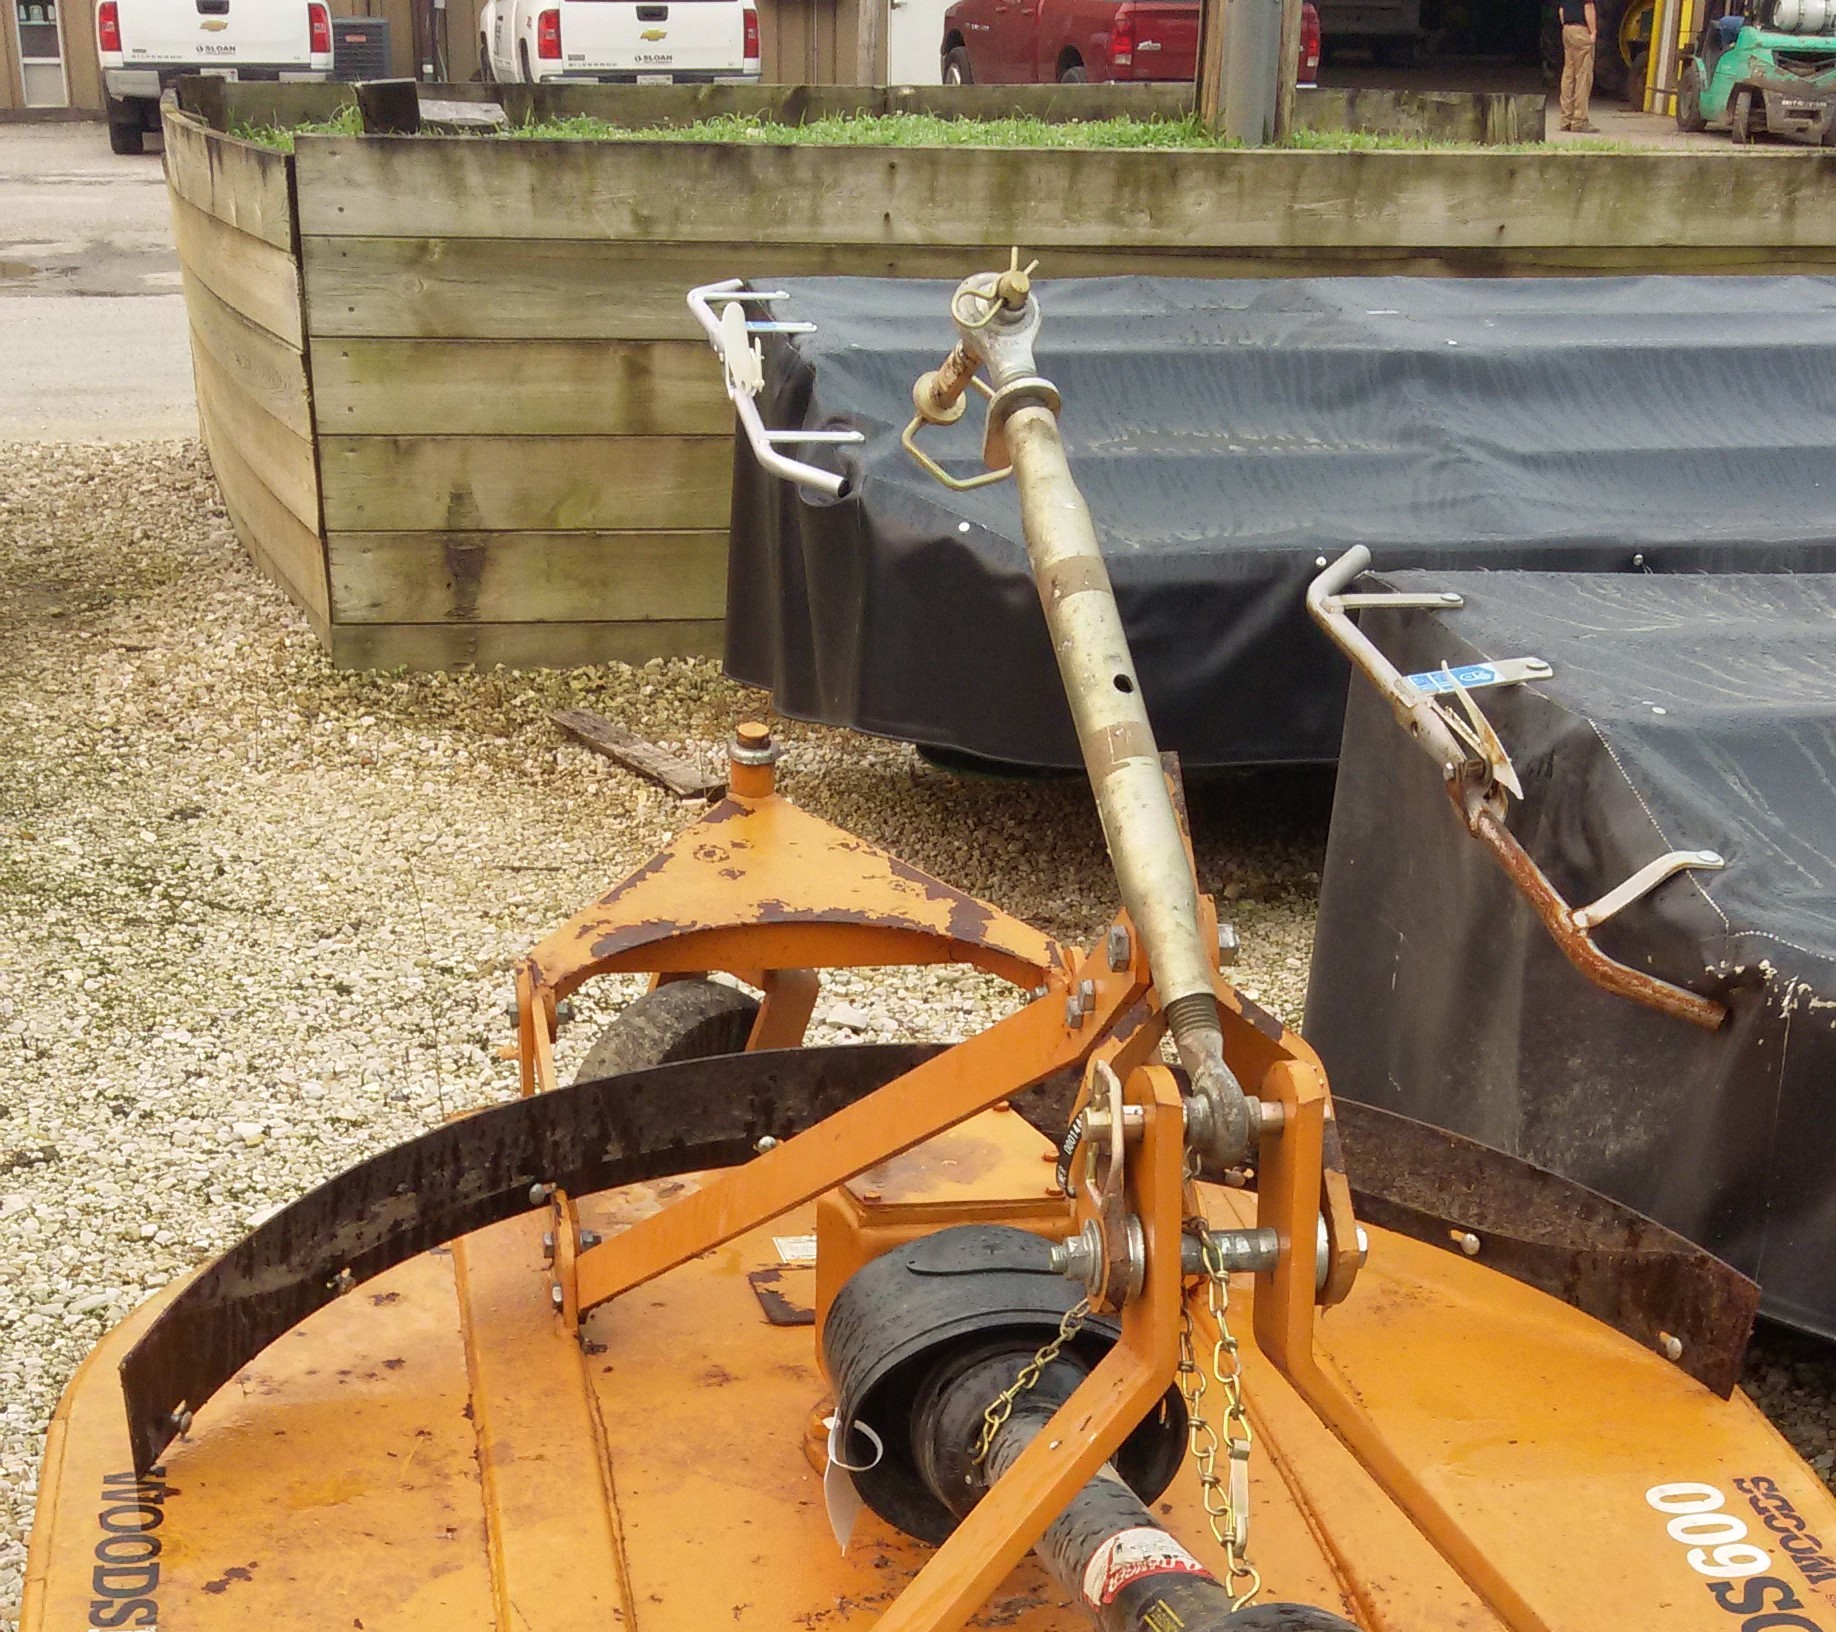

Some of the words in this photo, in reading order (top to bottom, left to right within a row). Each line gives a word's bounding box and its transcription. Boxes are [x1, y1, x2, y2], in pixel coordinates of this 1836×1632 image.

[88, 1466, 167, 1628] WOODS
[1645, 1482, 1772, 1578] 600
[1732, 1475, 1836, 1585] WOODS
